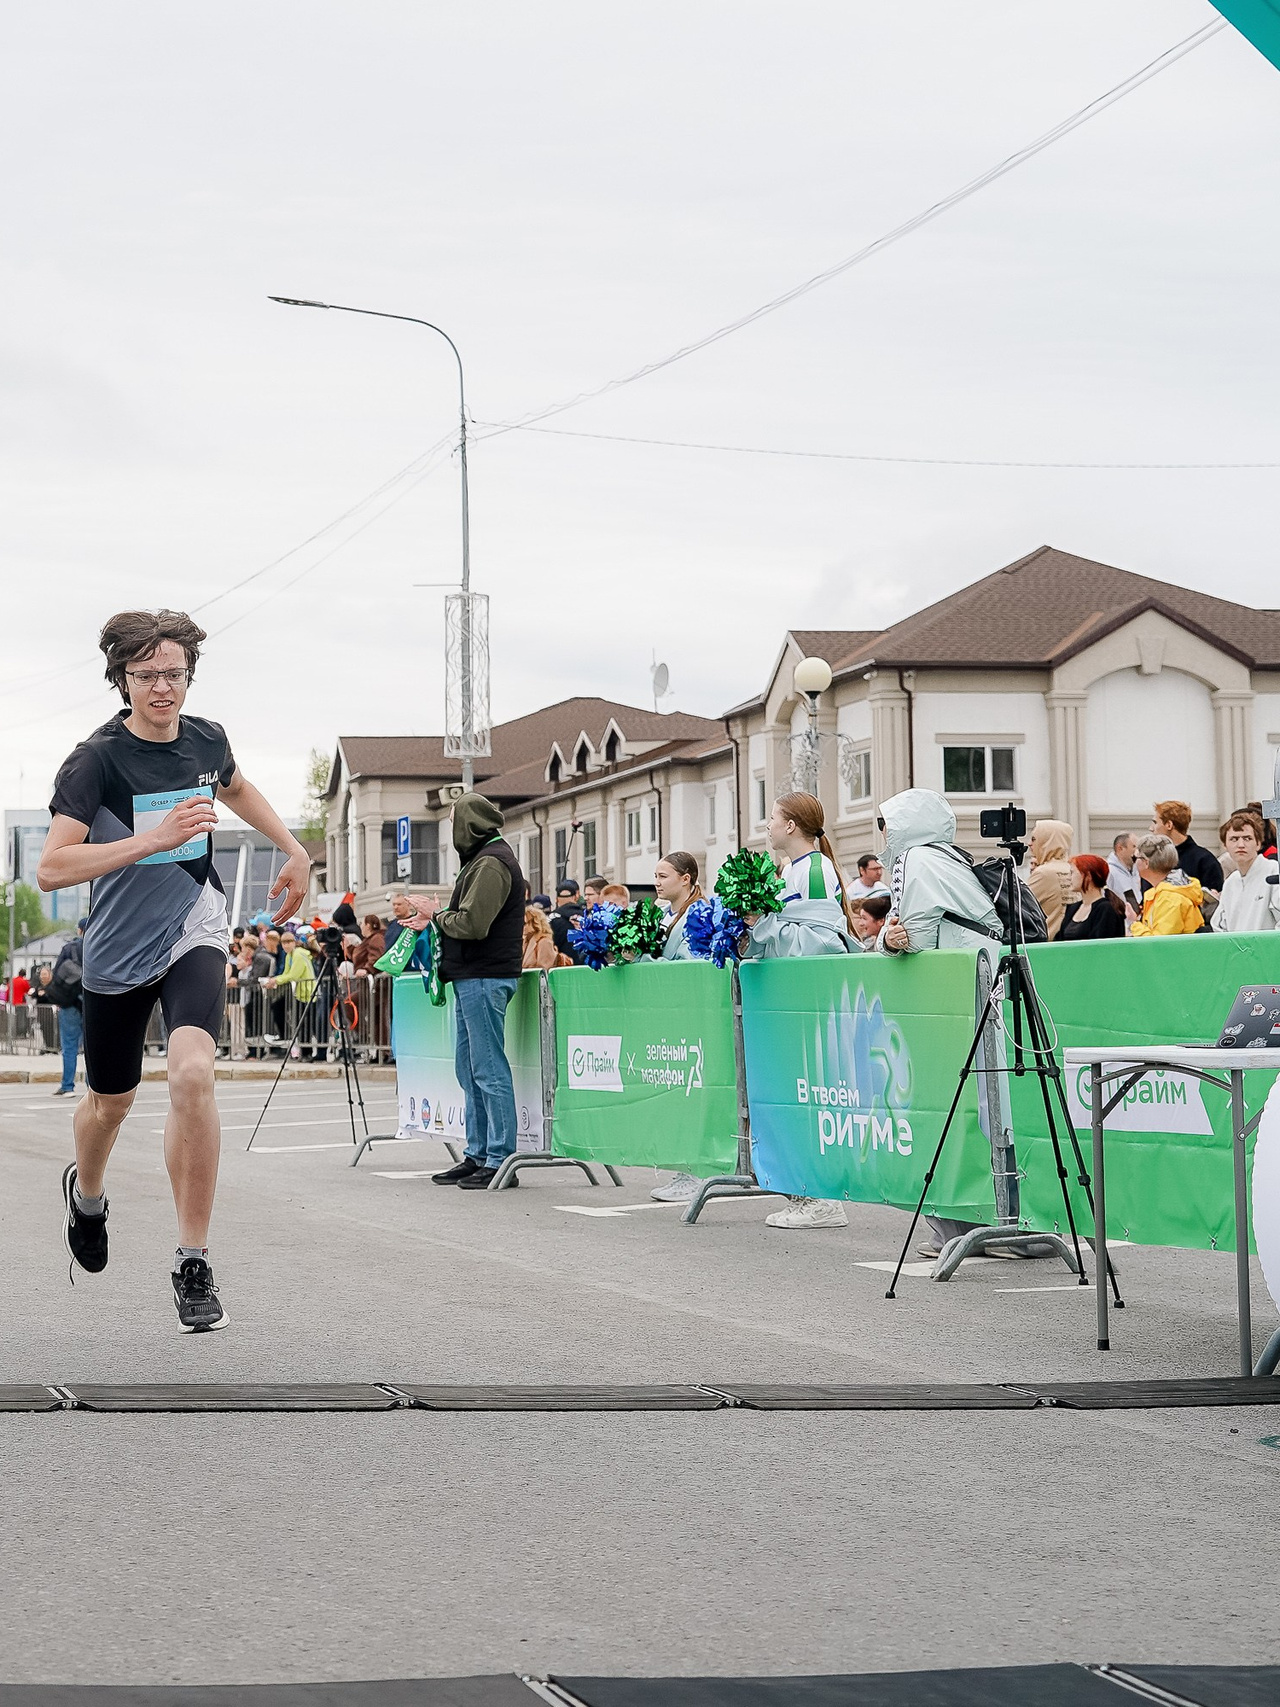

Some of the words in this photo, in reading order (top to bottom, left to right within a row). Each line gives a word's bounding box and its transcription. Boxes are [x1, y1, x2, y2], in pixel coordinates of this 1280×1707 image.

[198, 769, 219, 787] FILA
[646, 1038, 688, 1062] зелёный
[586, 1051, 615, 1077] Прайм
[641, 1062, 686, 1091] марафон
[796, 1078, 809, 1104] В
[811, 1080, 860, 1108] твоём
[818, 1110, 914, 1156] ритме
